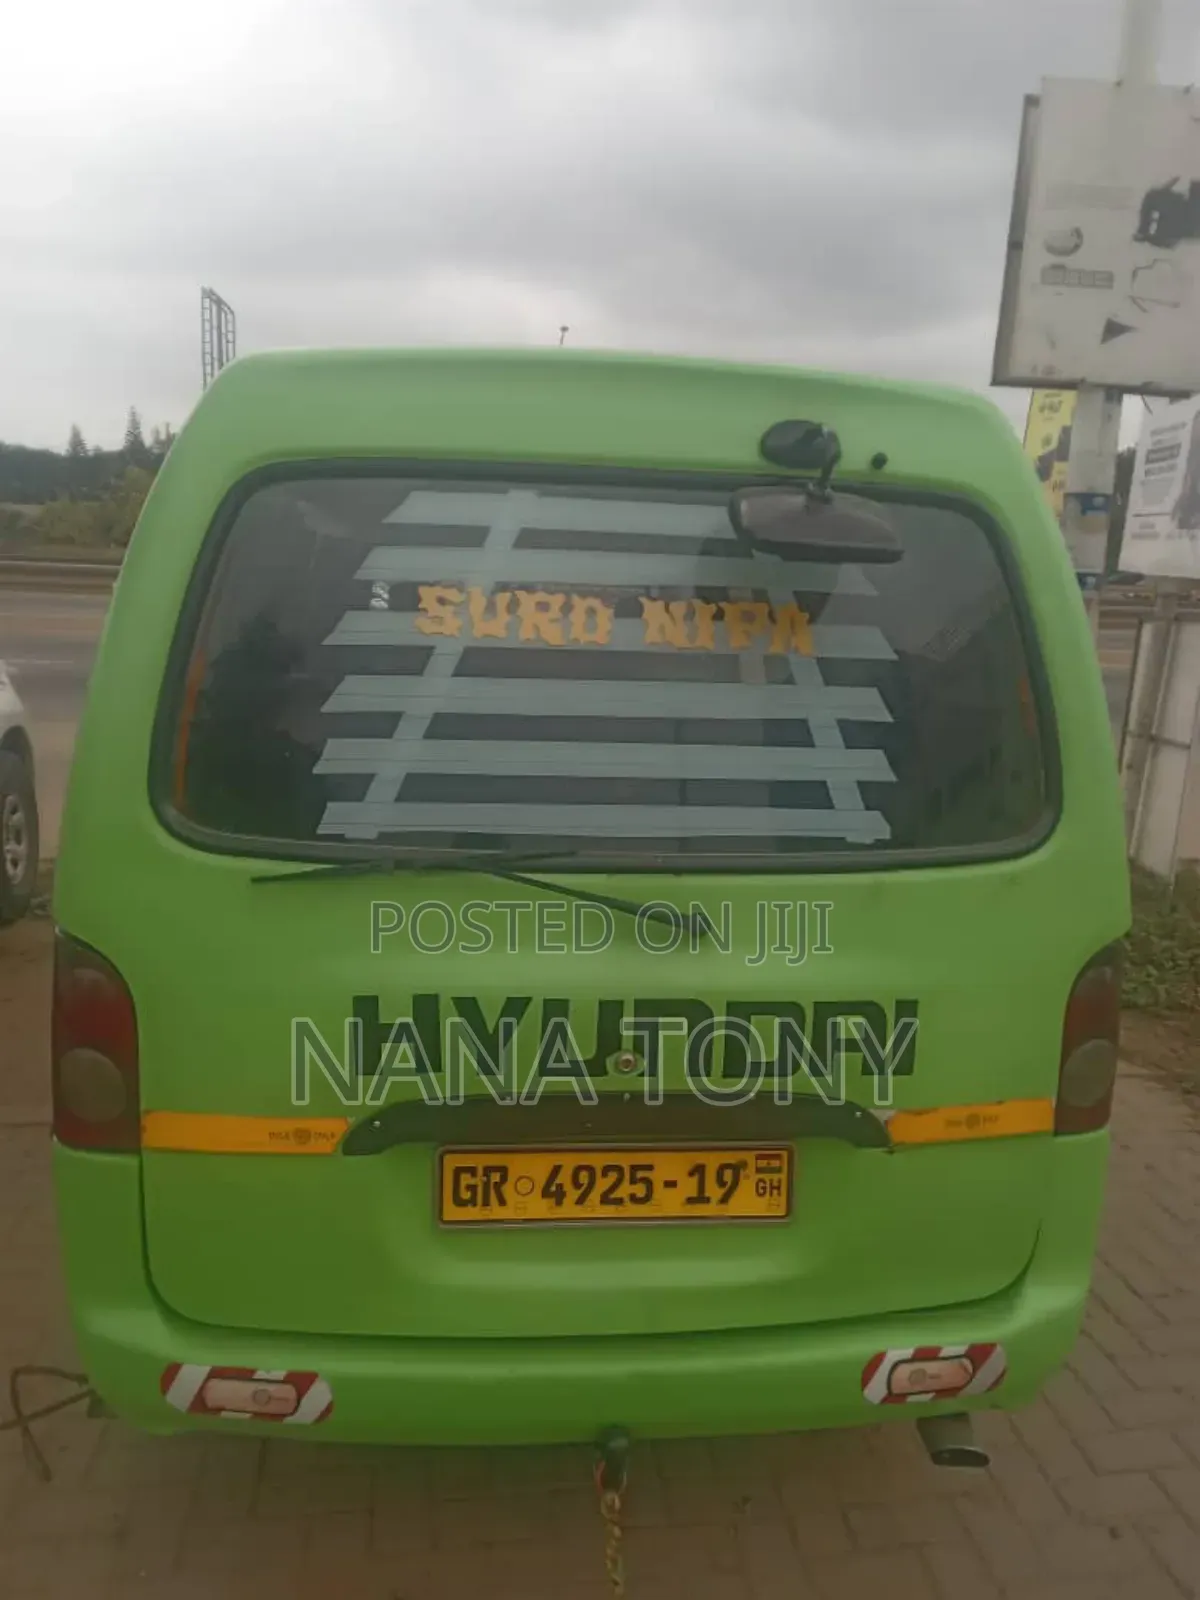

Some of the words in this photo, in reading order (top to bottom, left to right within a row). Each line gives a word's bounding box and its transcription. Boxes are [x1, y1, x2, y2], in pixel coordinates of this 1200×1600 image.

[638, 595, 814, 657] NIPA
[452, 1164, 509, 1208] GR
[540, 1162, 743, 1206] 4925-19
[755, 1178, 782, 1198] GH
